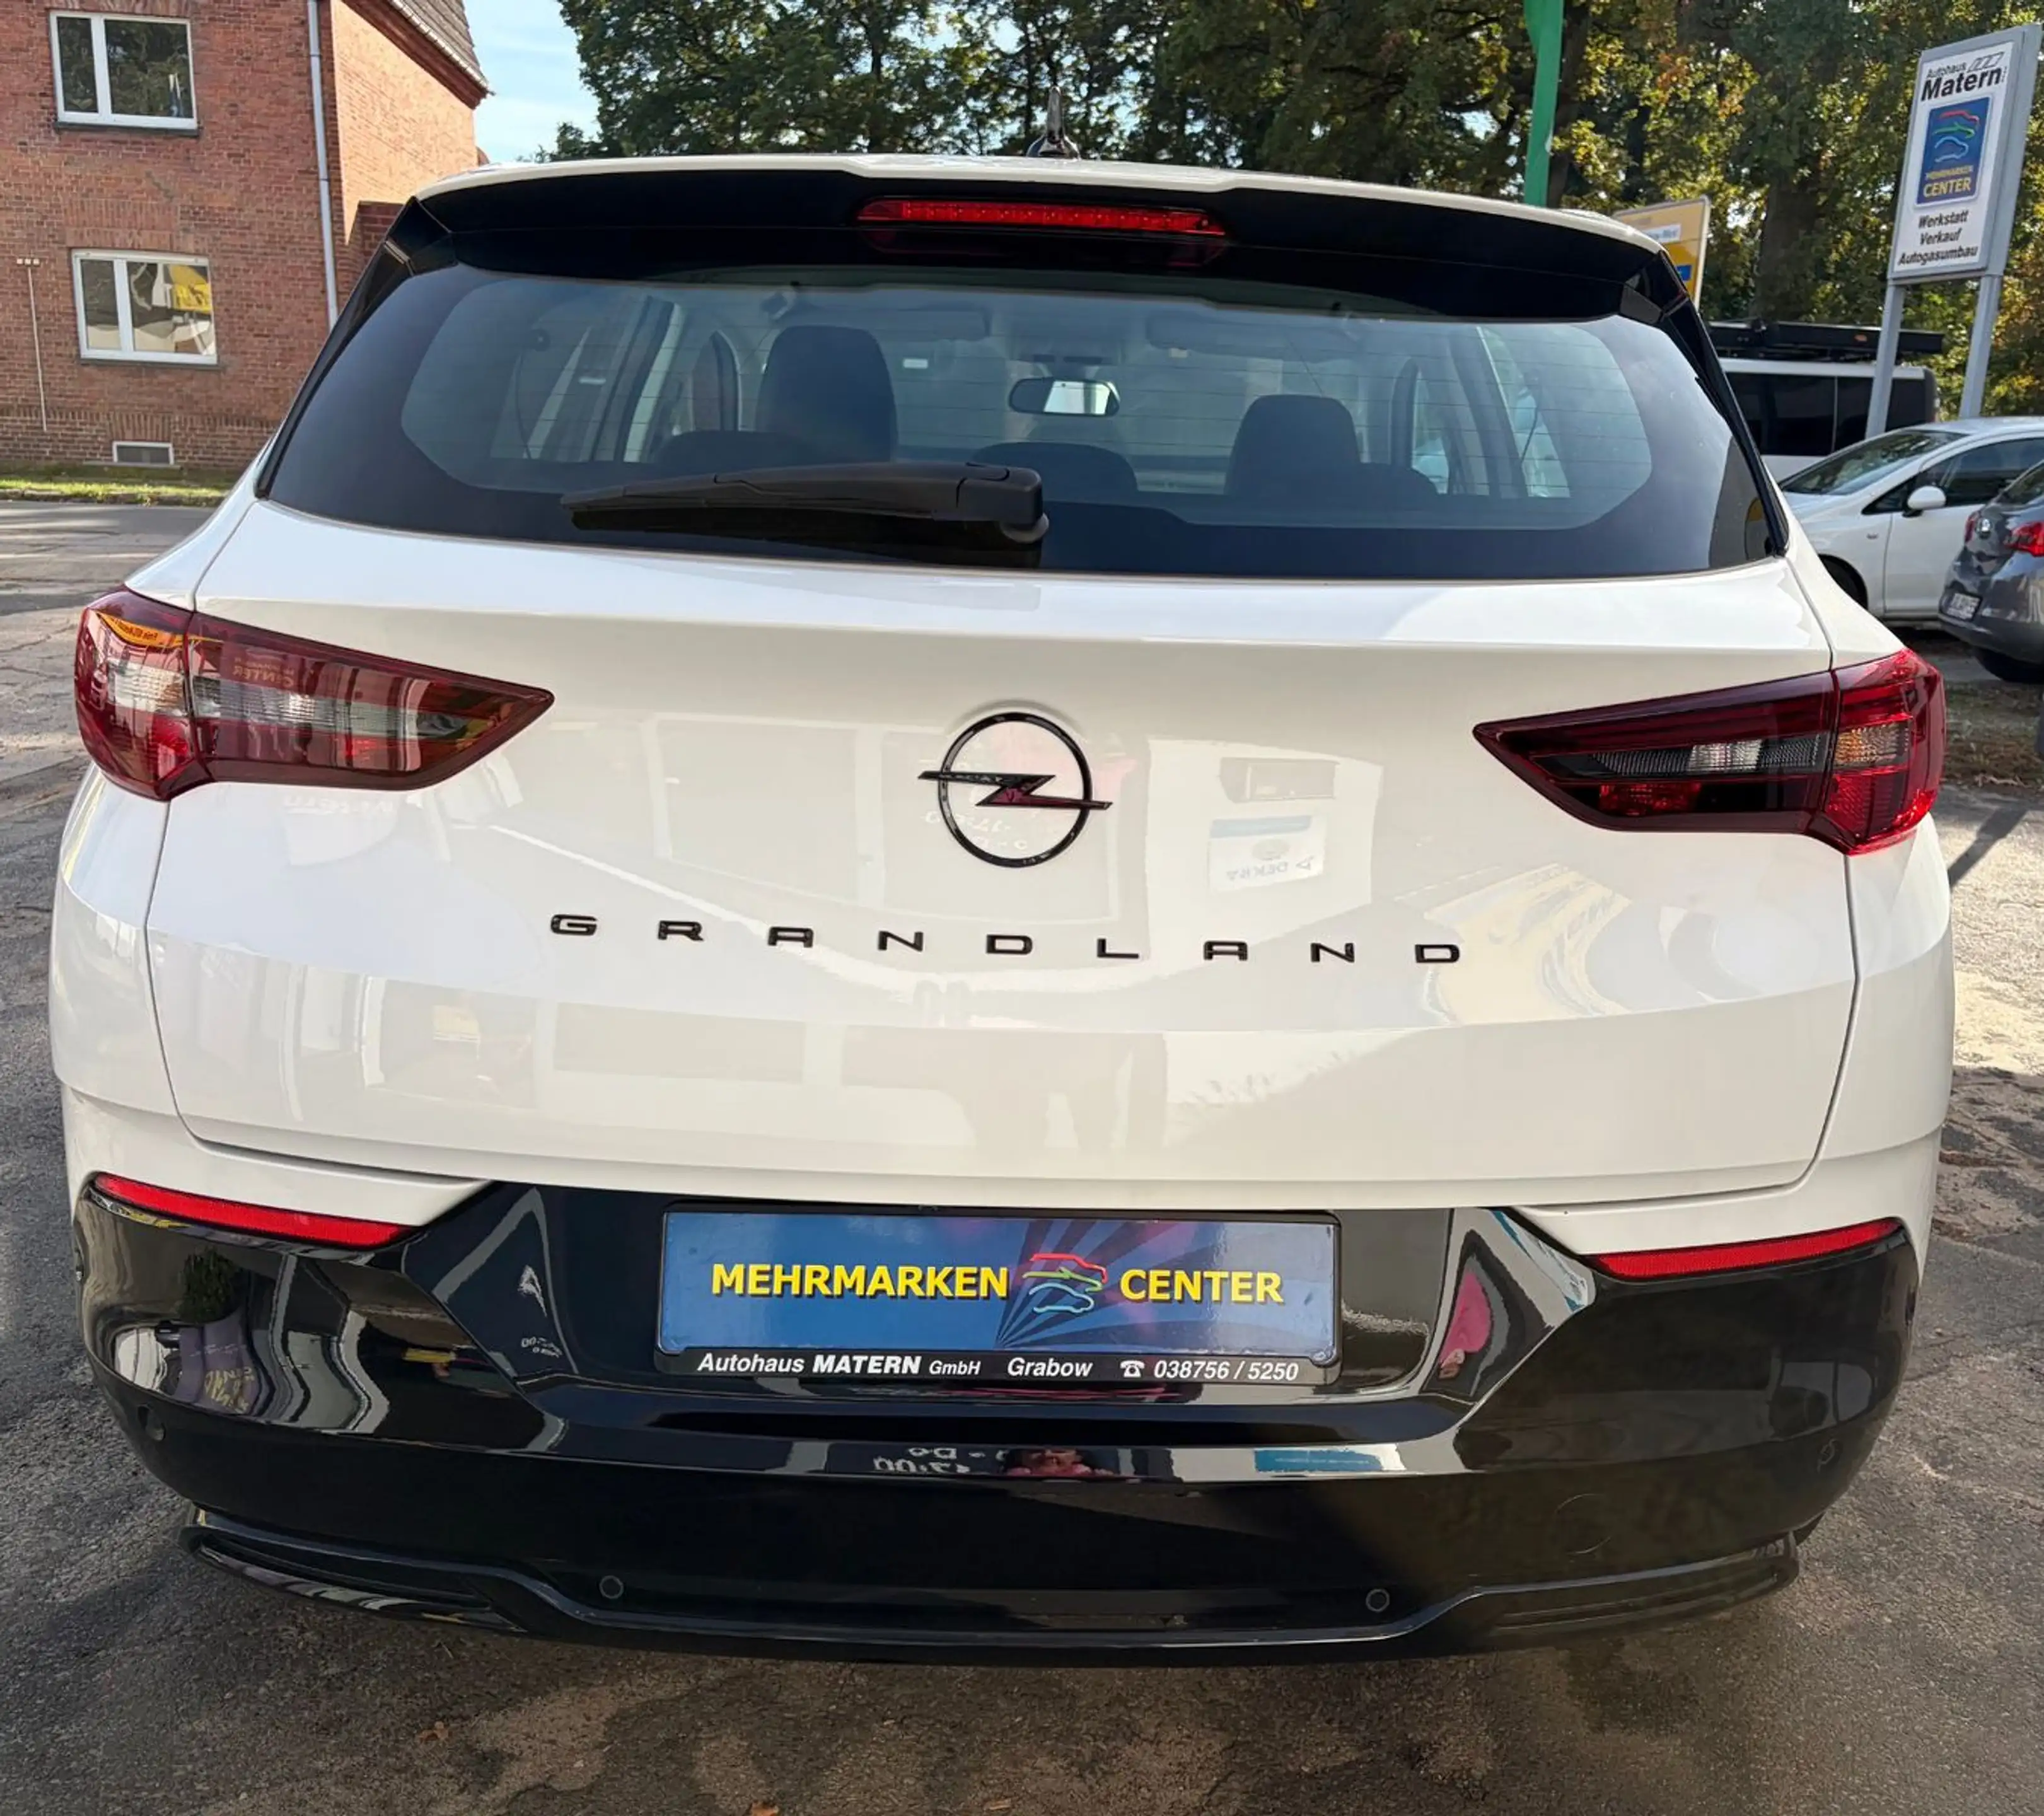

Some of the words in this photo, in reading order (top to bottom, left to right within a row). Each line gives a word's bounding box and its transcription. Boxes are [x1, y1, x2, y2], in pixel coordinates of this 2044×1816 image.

[1921, 67, 2002, 102] Matern
[1924, 177, 1971, 197] CENTER
[1919, 210, 1968, 228] Werkstatt
[1920, 228, 1963, 245] Verkauf
[1898, 246, 1978, 265] Autogasumbau
[550, 914, 1461, 963] GRANDLAND
[711, 1263, 1008, 1300] MEHRMARKEN
[1119, 1269, 1284, 1305] CENTER
[697, 1353, 805, 1373] Autohaus
[811, 1354, 922, 1375] MATERN
[928, 1360, 982, 1376] GmbH
[1007, 1358, 1094, 1377] Grabow
[1153, 1360, 1231, 1379] 038756
[1246, 1362, 1299, 1381] 5250
